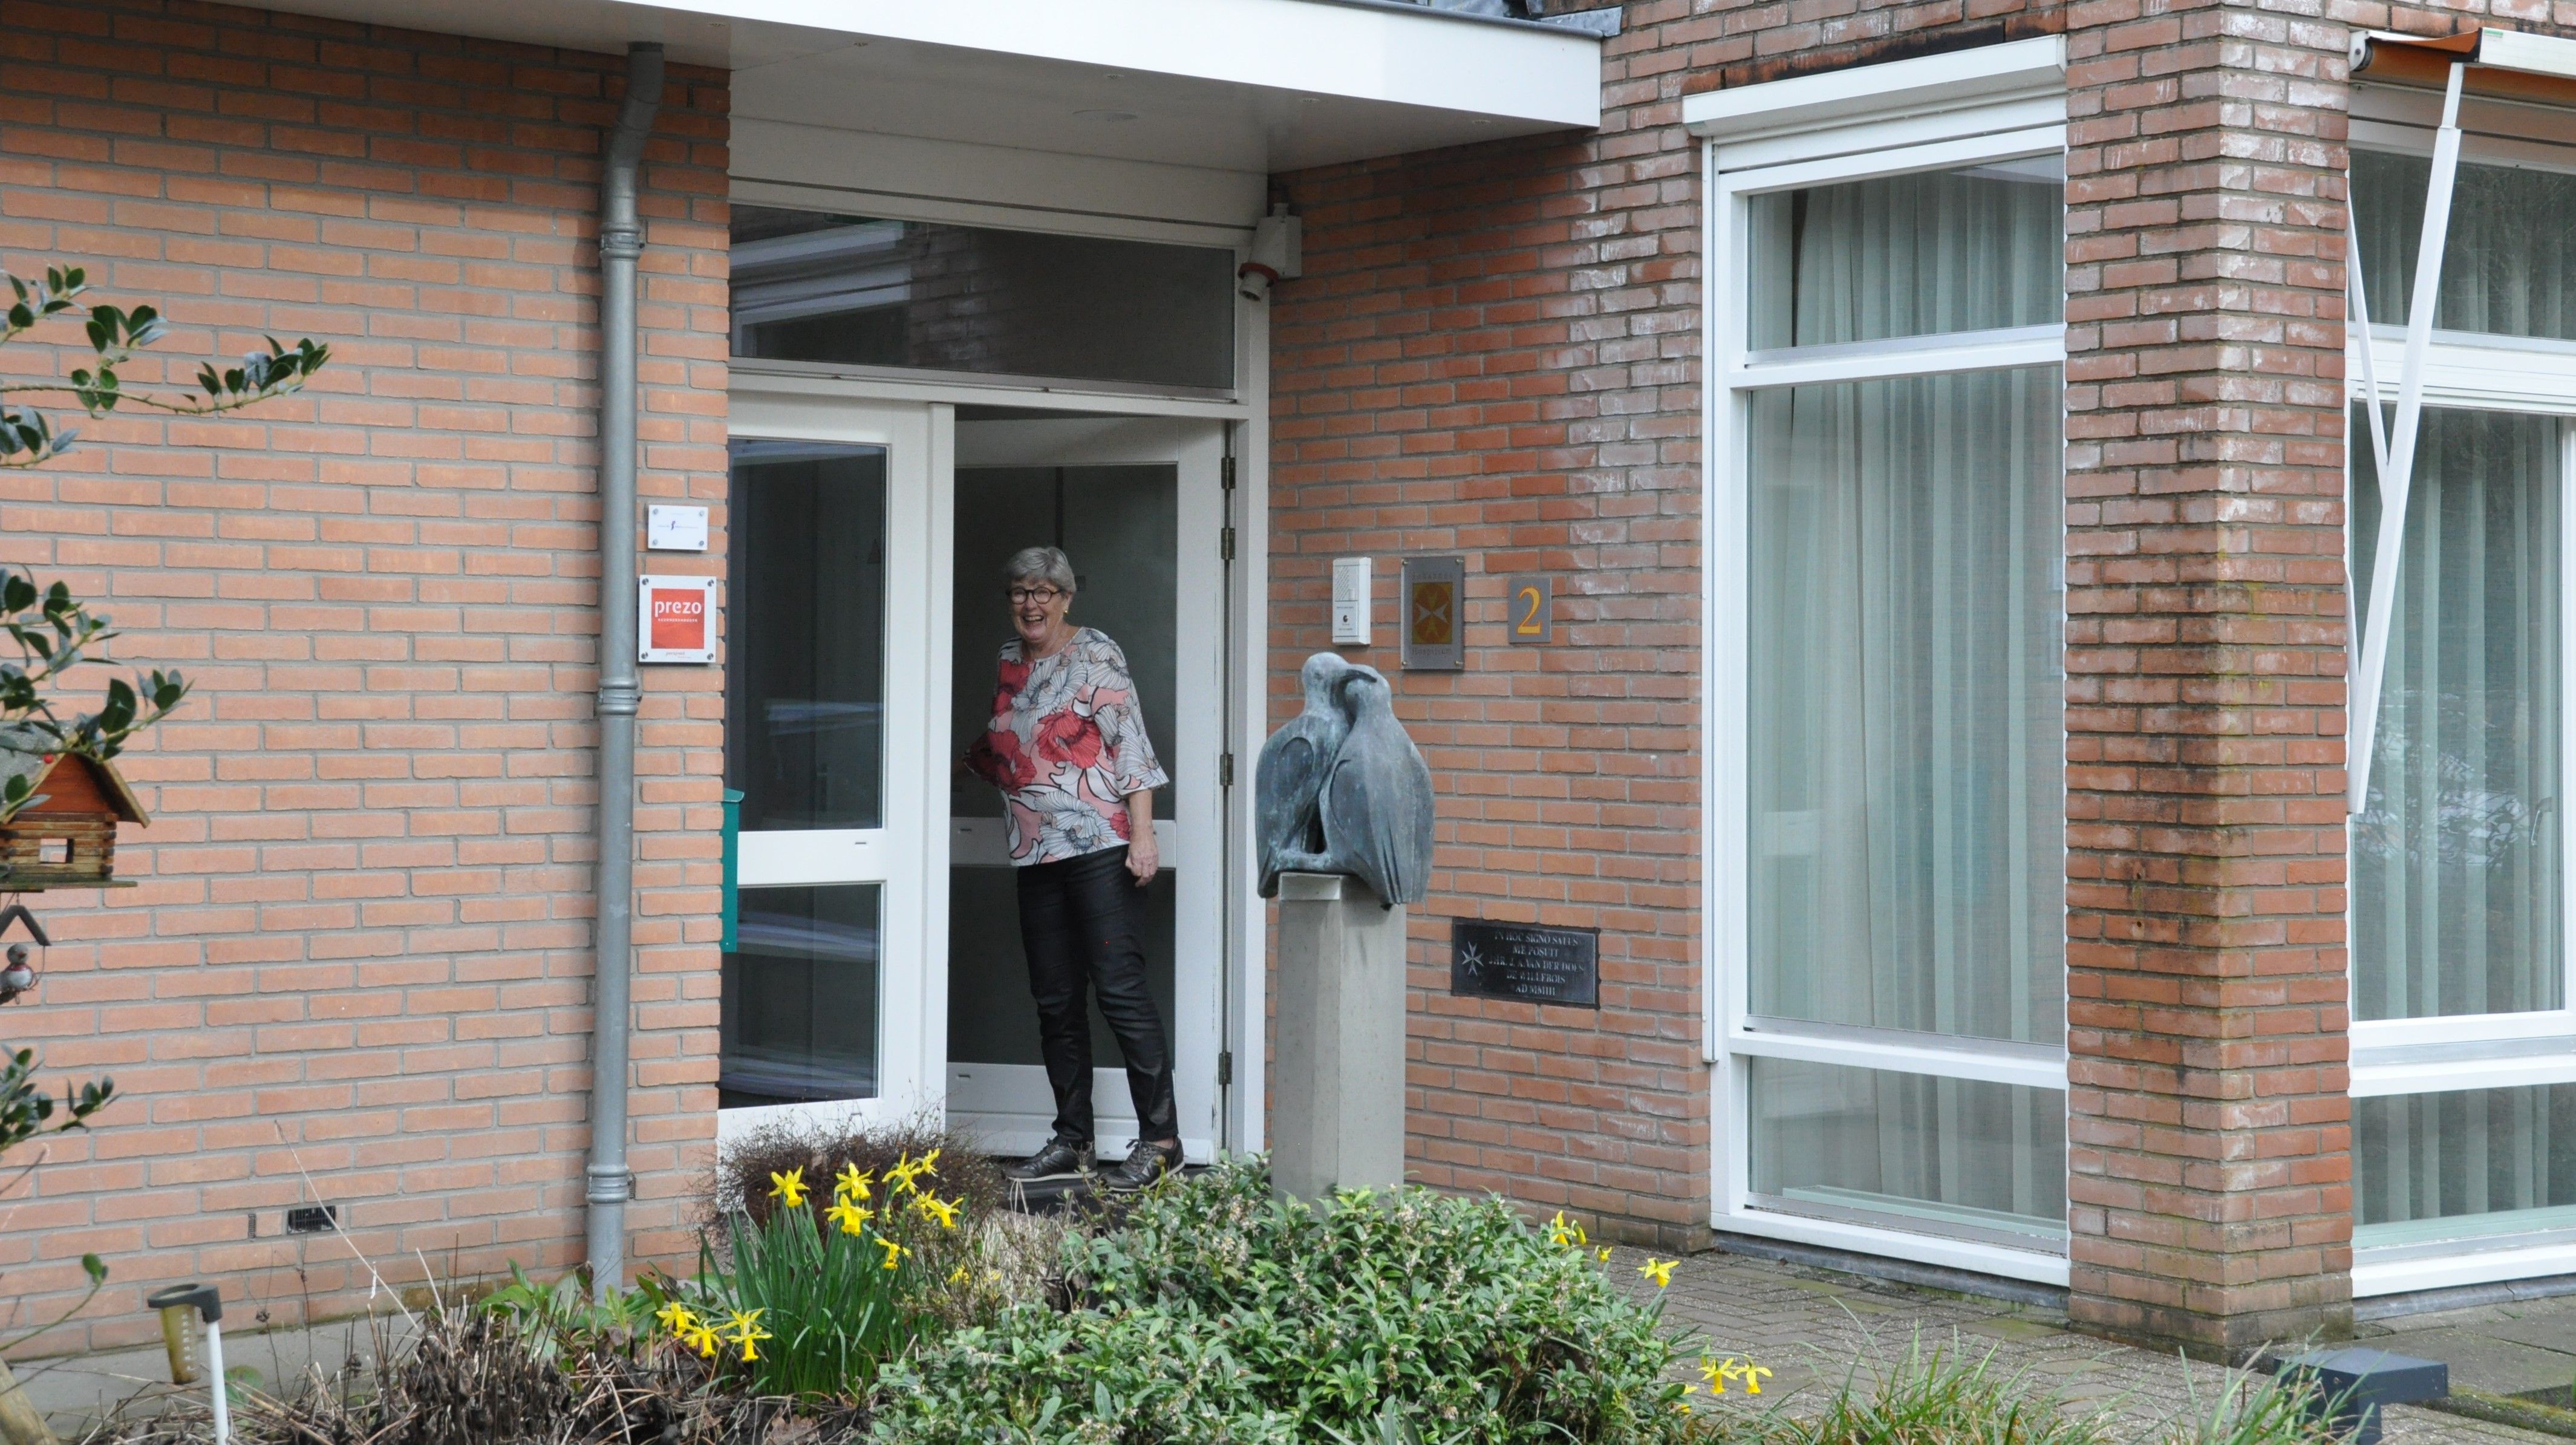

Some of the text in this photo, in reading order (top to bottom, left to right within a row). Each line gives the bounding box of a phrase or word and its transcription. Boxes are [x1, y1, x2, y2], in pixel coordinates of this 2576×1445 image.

[654, 601, 702, 617] prezo
[1516, 586, 1542, 634] 2
[1506, 931, 1524, 941] HOC
[1525, 933, 1550, 944] SIGNO
[1513, 945, 1558, 957] ME POSUIT
[1543, 961, 1559, 970] DER
